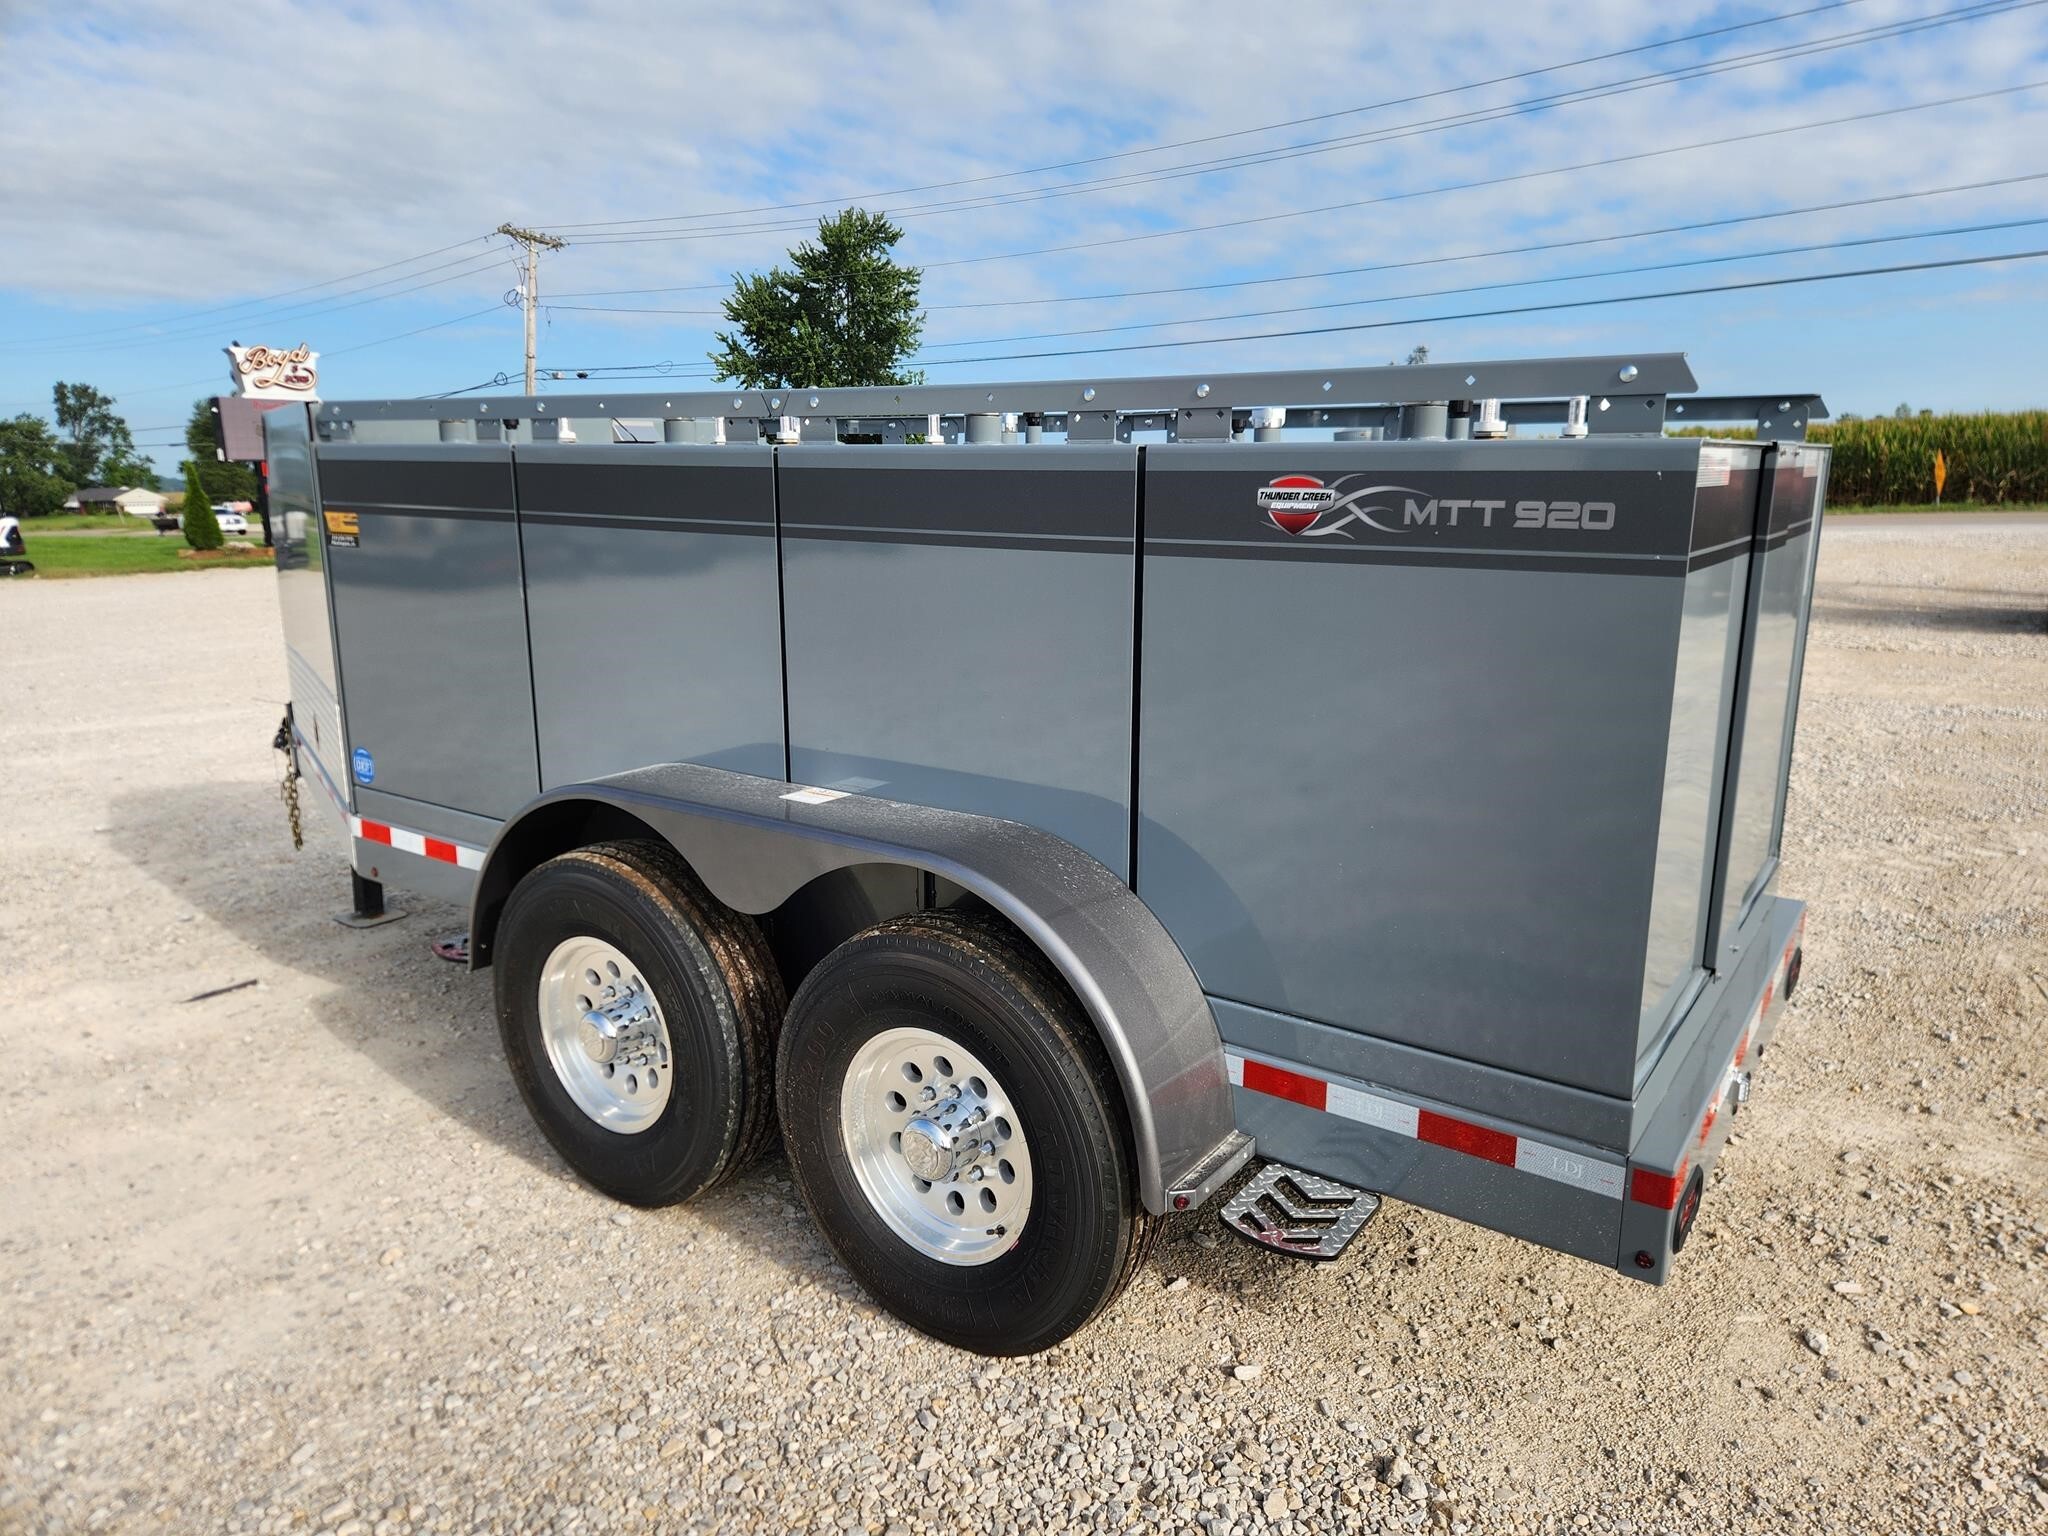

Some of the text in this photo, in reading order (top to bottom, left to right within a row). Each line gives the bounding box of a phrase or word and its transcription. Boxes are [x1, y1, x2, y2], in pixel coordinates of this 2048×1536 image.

[239, 343, 316, 390] Boyd
[1259, 491, 1333, 501] THUNDER CREEK
[1270, 502, 1320, 510] EQUIPMENT
[1403, 499, 1617, 530] MTT 920
